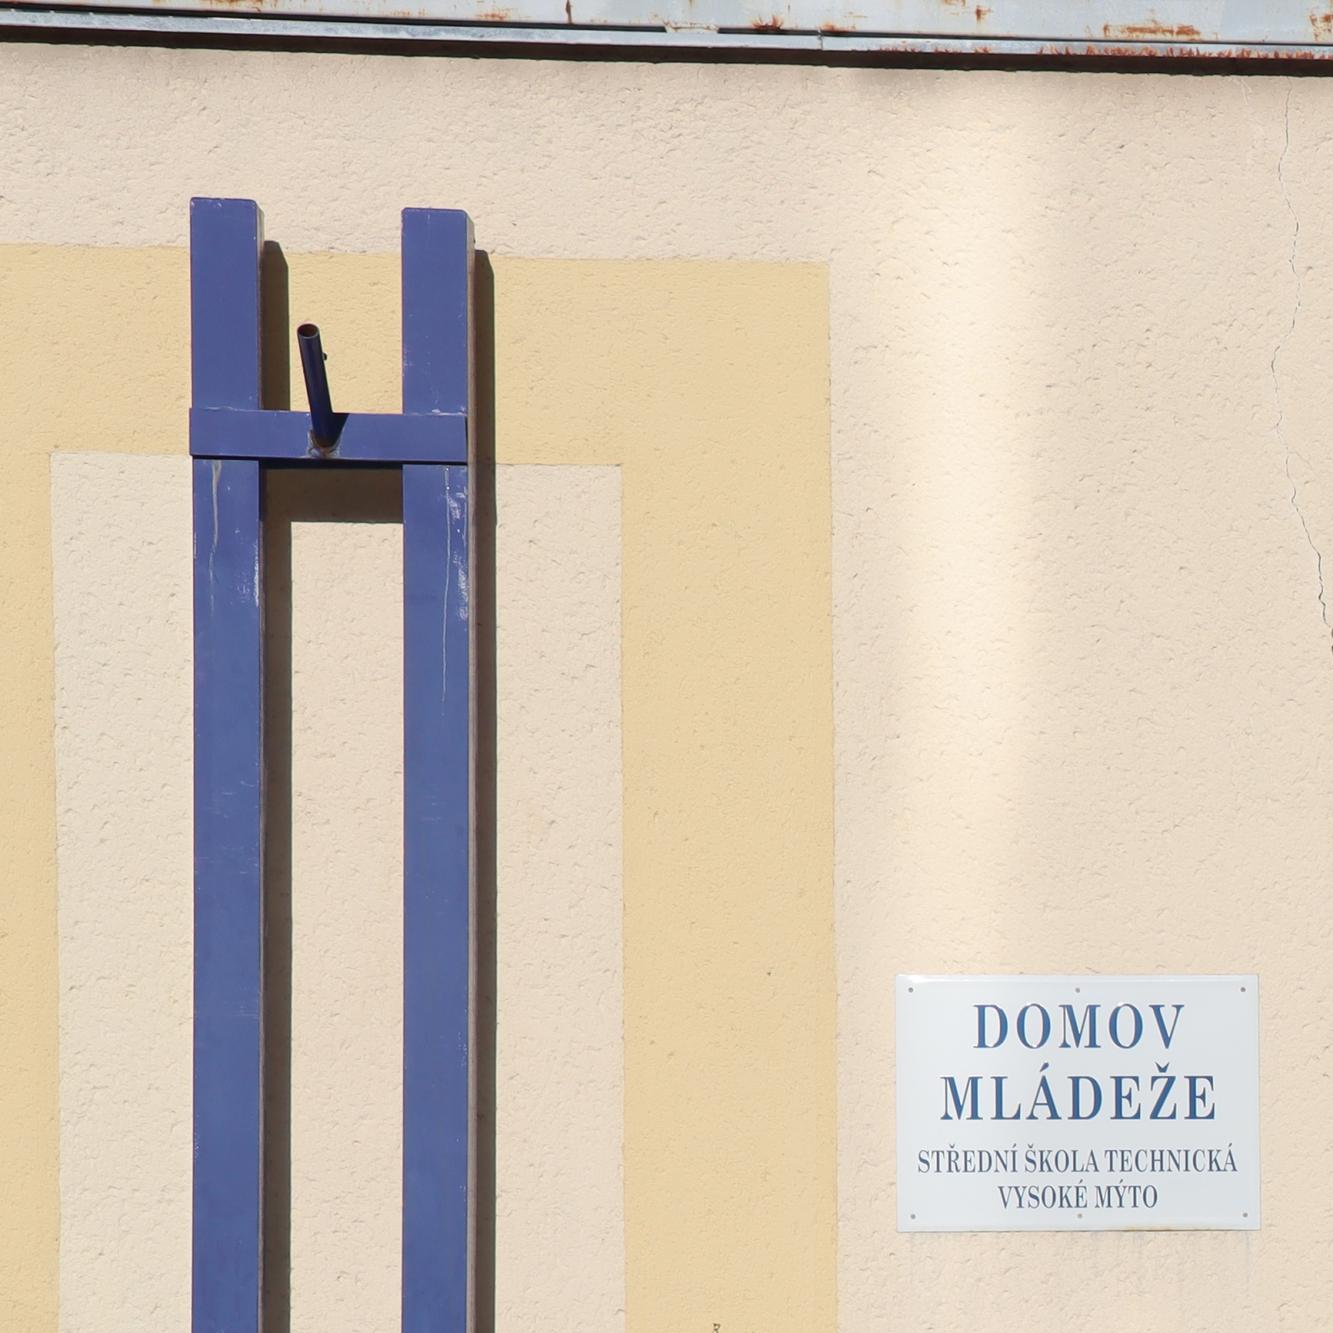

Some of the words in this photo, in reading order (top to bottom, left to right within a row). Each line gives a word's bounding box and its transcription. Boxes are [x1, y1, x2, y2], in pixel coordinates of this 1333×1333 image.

[973, 1003, 1185, 1050] DOMOV
[940, 1062, 1216, 1121] MLÁDEŽE
[918, 1143, 1018, 1173] STŘEDNÍ
[1024, 1143, 1100, 1173] ŠKOLA
[1104, 1142, 1238, 1173] TECHNICKÁ
[997, 1178, 1088, 1209] VYSOKÉ
[1094, 1178, 1158, 1209] MÝTO
